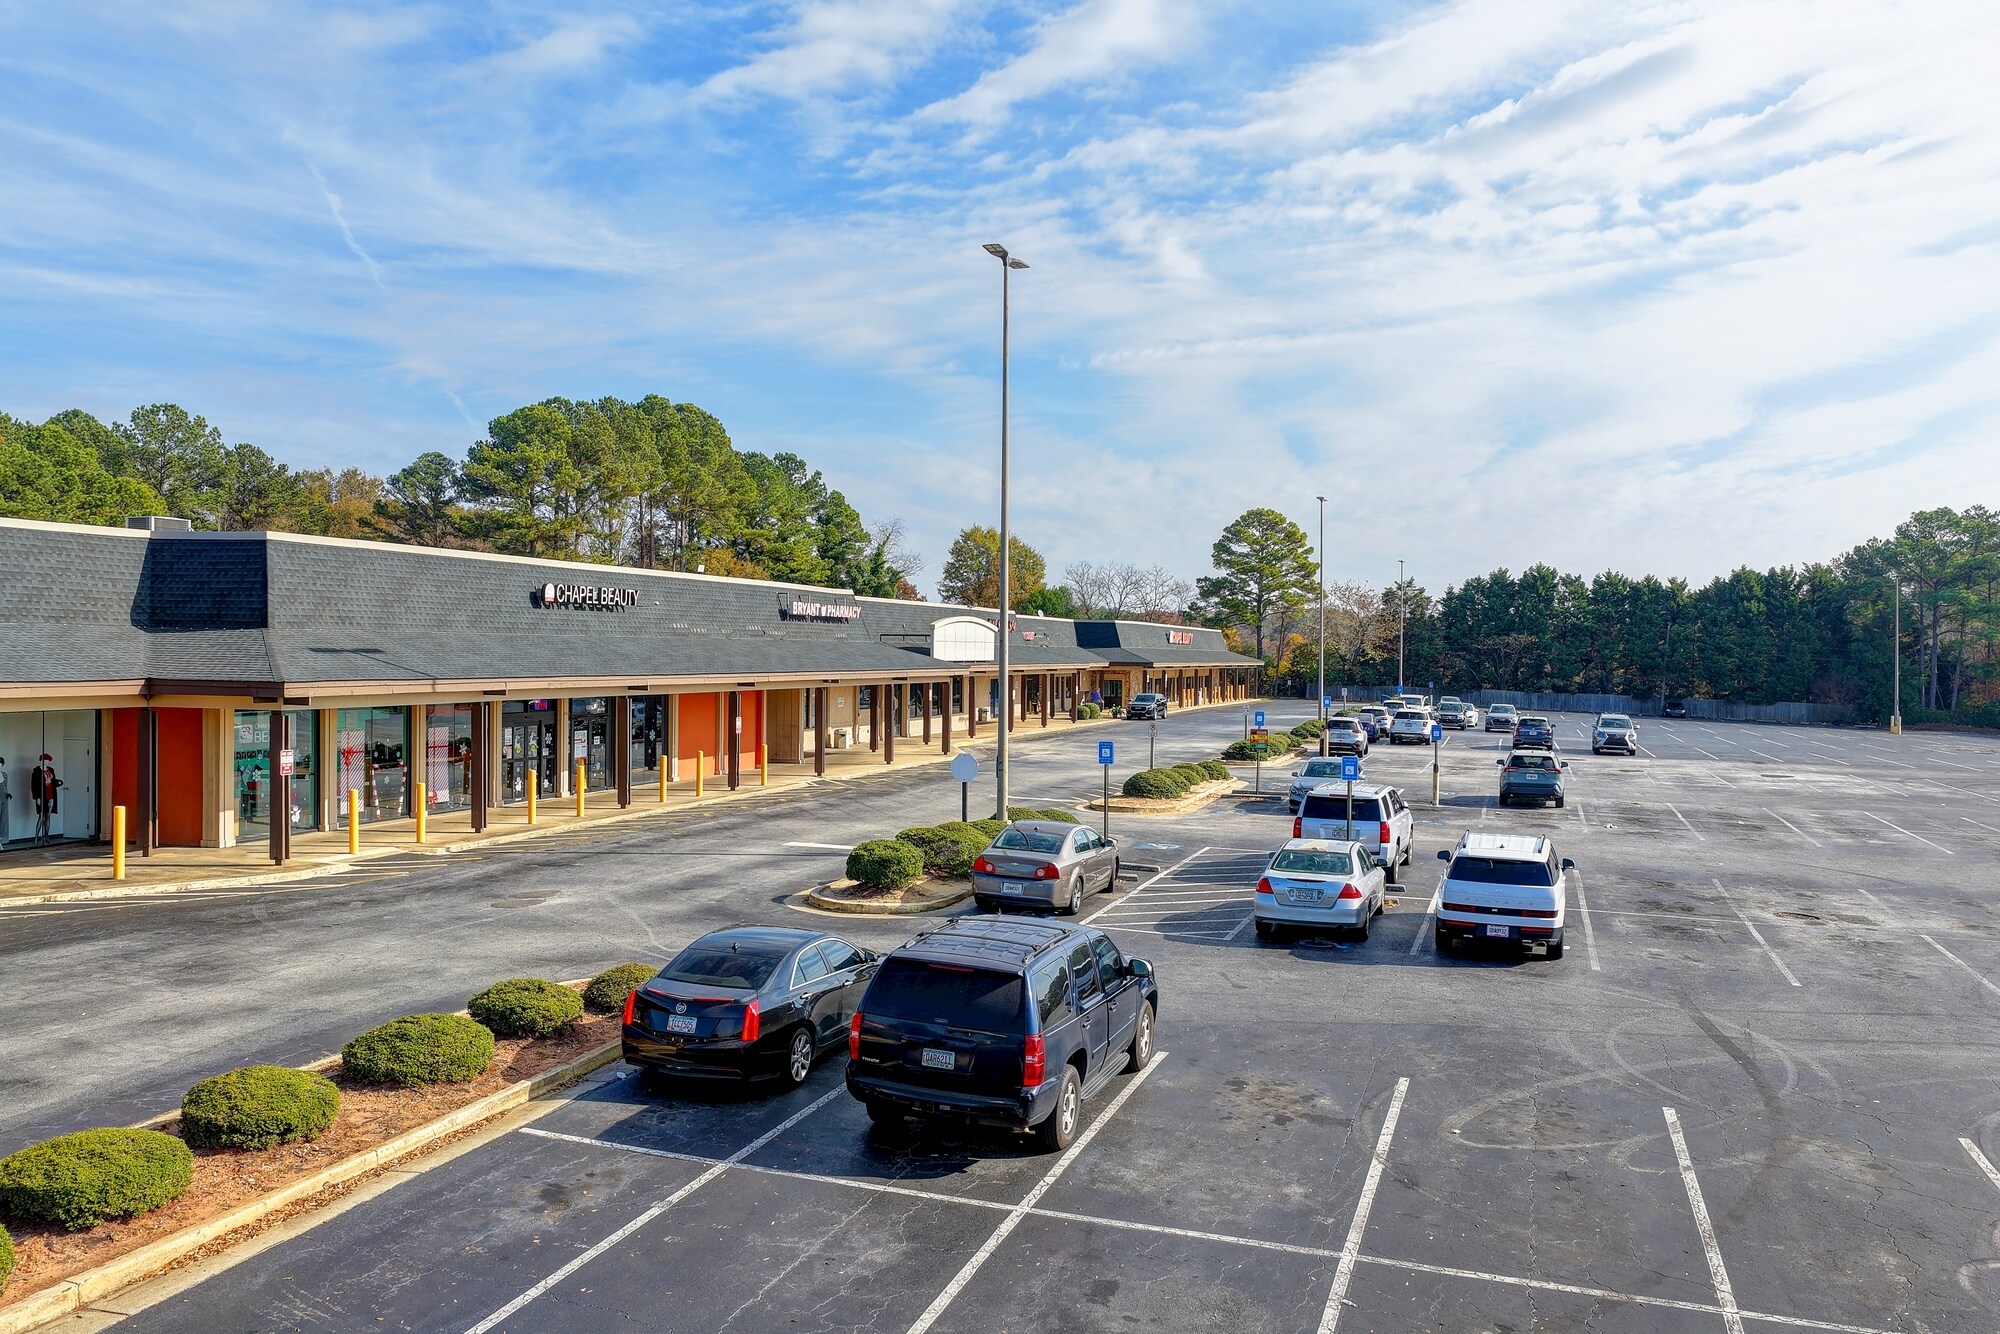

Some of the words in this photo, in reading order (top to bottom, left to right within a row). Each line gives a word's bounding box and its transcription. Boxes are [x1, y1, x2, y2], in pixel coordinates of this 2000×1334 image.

[556, 584, 599, 604] CHAPEL
[600, 587, 640, 607] BEAUTY
[792, 602, 820, 617] BRYANT
[827, 604, 862, 618] PHARMACY
